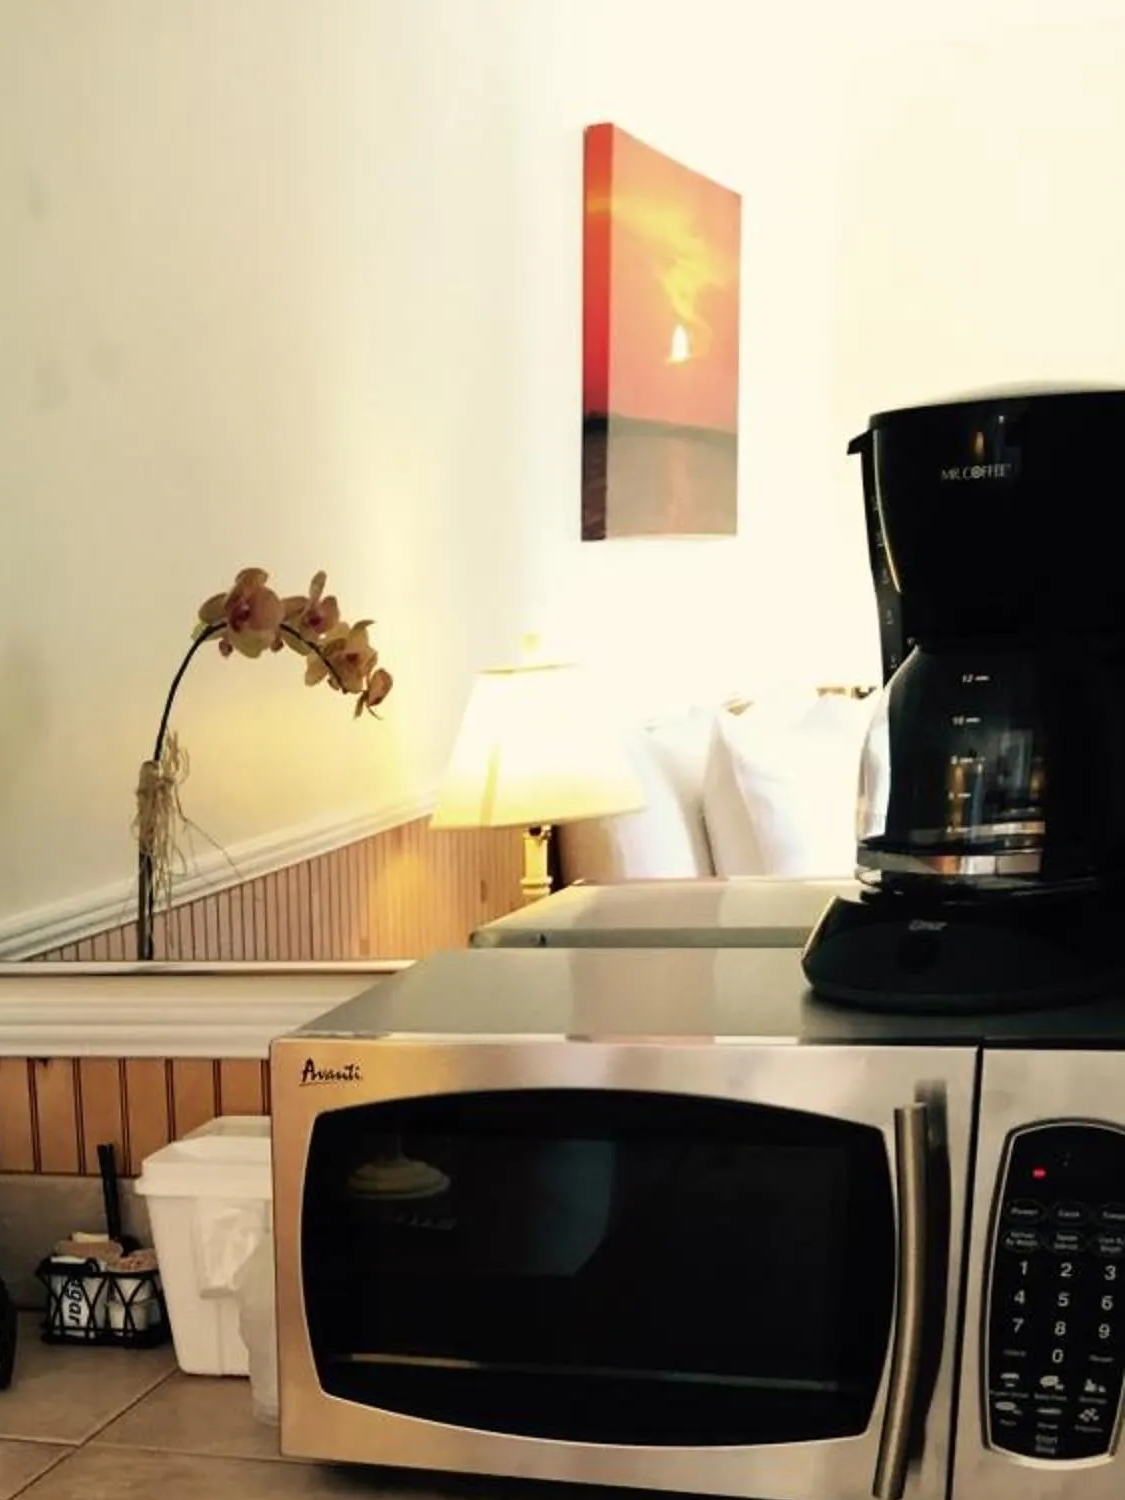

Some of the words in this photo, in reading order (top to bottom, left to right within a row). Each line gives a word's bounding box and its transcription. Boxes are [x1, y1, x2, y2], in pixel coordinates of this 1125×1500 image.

[300, 1057, 361, 1084] Avanti
[1020, 1260, 1028, 1276] 1
[1060, 1261, 1073, 1278] 2
[1104, 1264, 1116, 1281] 3
[65, 1277, 82, 1326] ugar
[1014, 1289, 1025, 1305] 4
[1057, 1291, 1070, 1307] 5
[1101, 1295, 1113, 1311] 6
[1012, 1317, 1024, 1333] 7
[1054, 1320, 1066, 1336] 8
[1098, 1323, 1110, 1339] 9
[1052, 1348, 1064, 1363] 0
